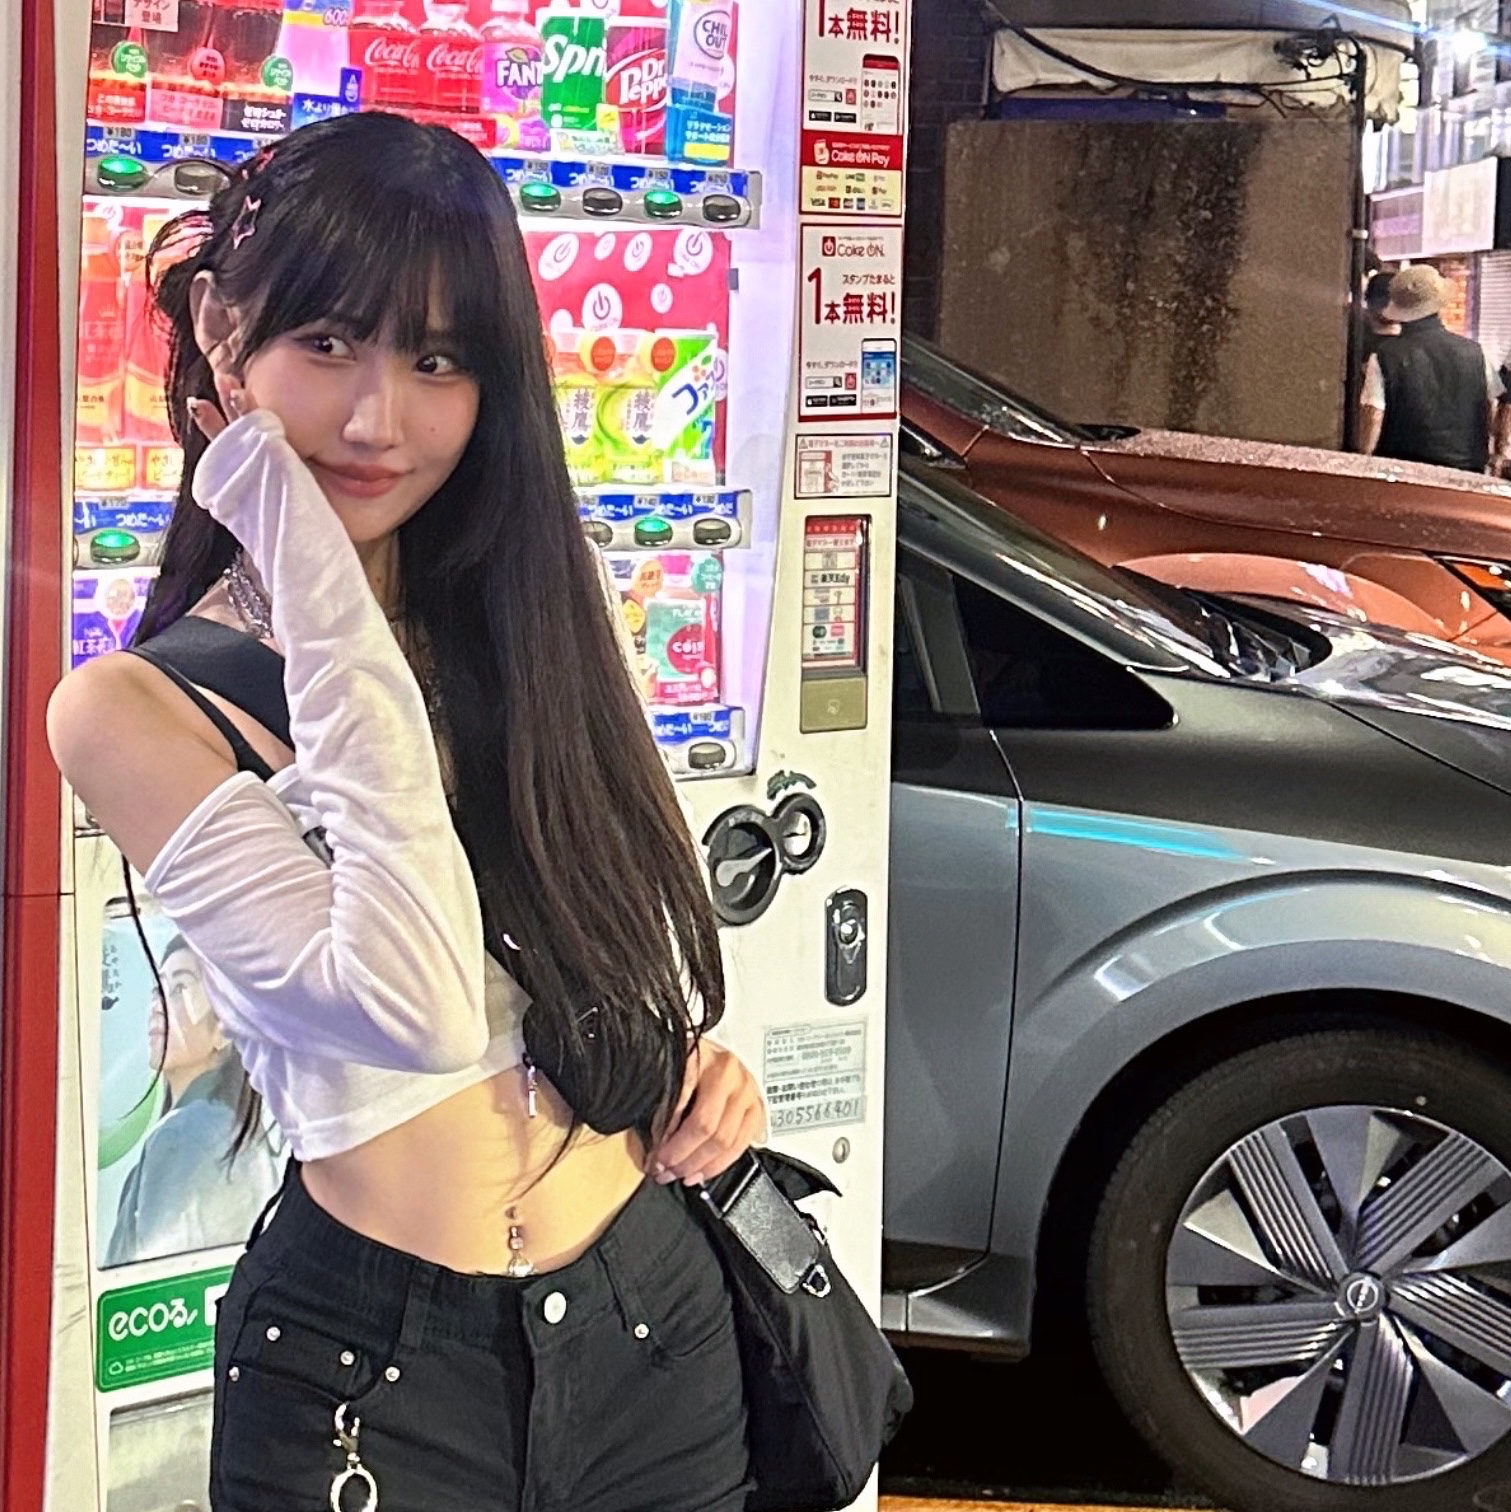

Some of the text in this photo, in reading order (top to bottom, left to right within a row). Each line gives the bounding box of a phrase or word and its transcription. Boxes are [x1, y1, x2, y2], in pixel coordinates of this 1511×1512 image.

[701, 20, 728, 39] CHIL
[542, 34, 606, 83] Spri
[836, 243, 865, 258] Coke
[807, 266, 896, 326] 1本無料!
